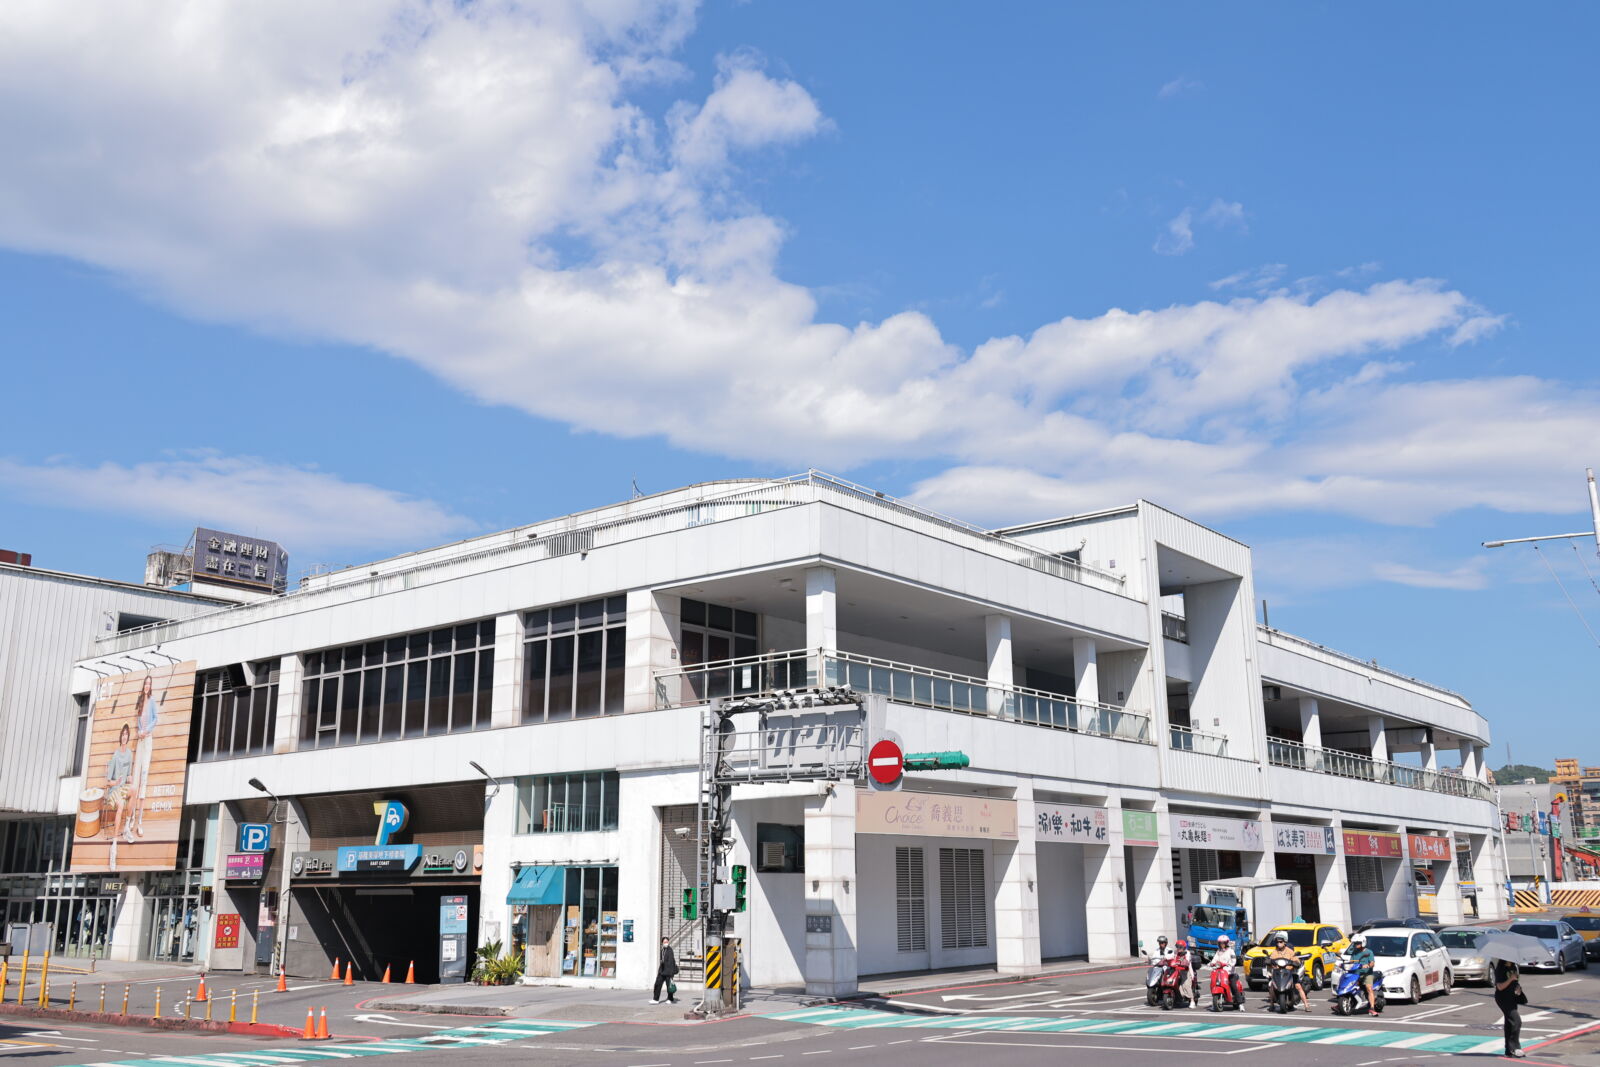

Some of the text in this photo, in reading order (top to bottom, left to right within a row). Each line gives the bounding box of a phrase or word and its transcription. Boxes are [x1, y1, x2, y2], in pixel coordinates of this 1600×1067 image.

[208, 536, 268, 559] 金融理財
[205, 555, 266, 578] 盡在二信
[152, 800, 173, 812] REMIX
[930, 803, 963, 823] 喬義思
[247, 829, 265, 850] P
[1095, 826, 1106, 840] 4F
[1276, 829, 1306, 848] はま寿司
[1305, 831, 1321, 839] HAMA
[1326, 830, 1335, 849] は
[105, 882, 124, 891] NET
